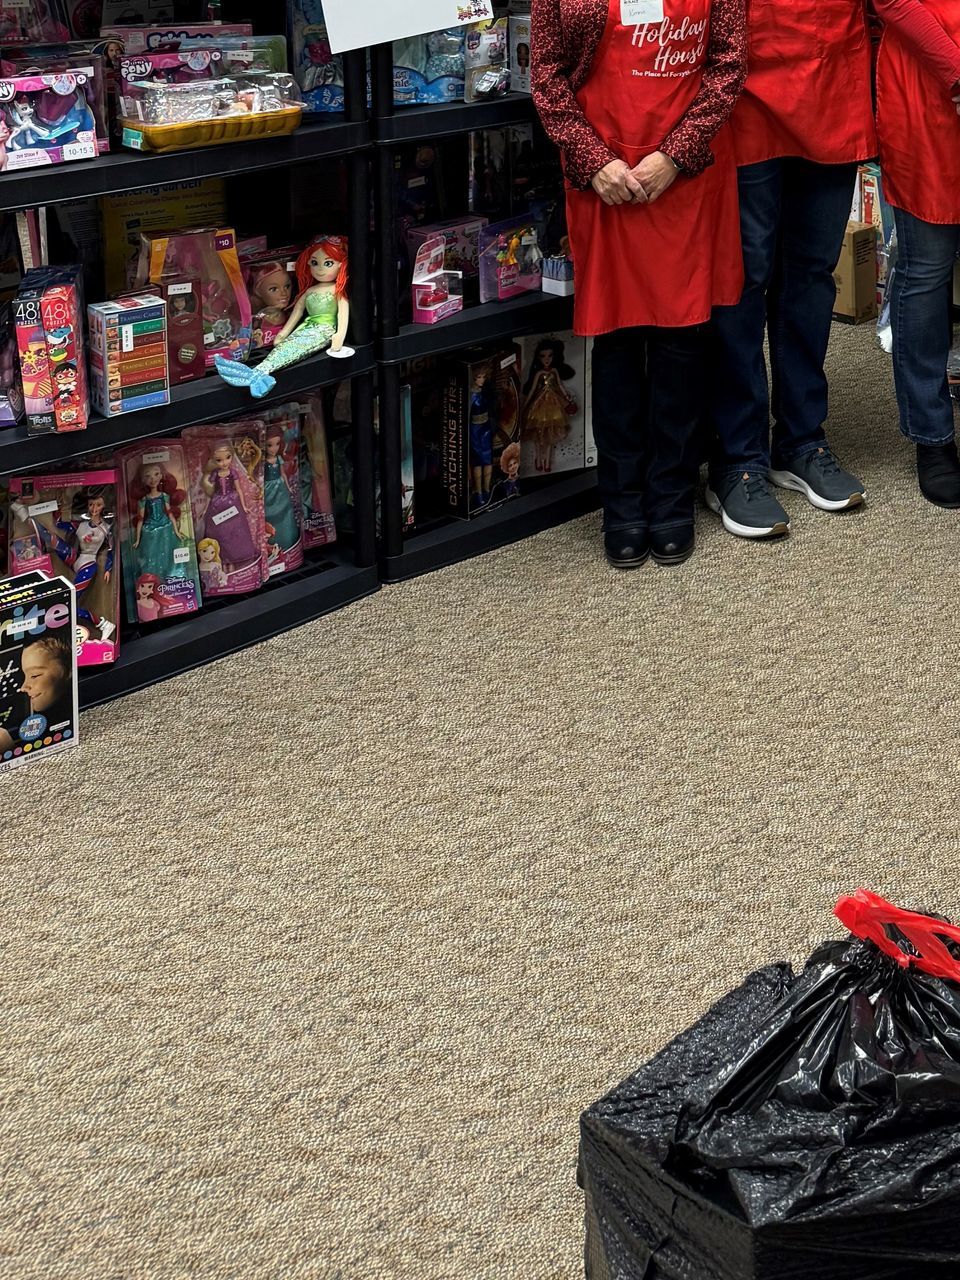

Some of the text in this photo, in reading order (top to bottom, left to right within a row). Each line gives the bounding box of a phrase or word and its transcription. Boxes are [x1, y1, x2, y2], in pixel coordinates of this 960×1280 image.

[631, 16, 707, 48] Holiday
[654, 42, 705, 72] House
[121, 62, 153, 81] PONY
[631, 69, 643, 77] The
[68, 148, 88, 156] 10-15
[16, 302, 38, 321] 48
[43, 303, 66, 320] 48
[448, 376, 457, 506] CATCHING FIRE
